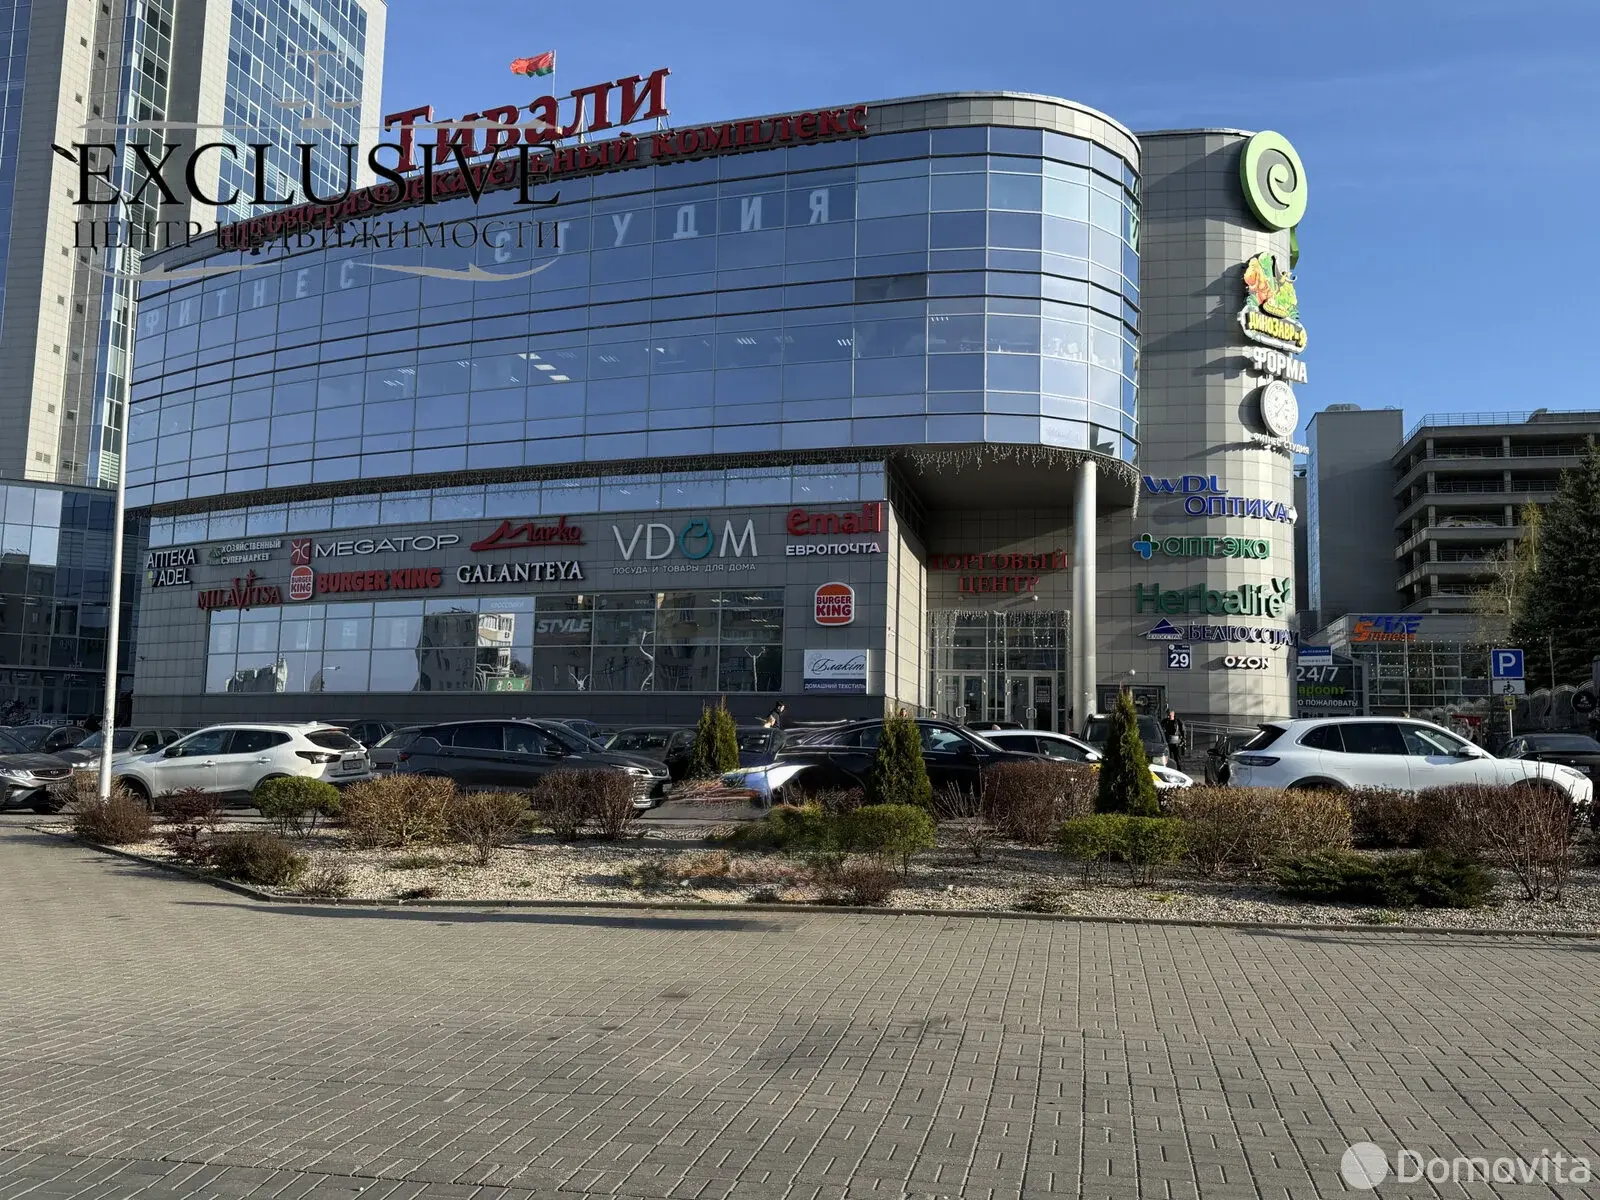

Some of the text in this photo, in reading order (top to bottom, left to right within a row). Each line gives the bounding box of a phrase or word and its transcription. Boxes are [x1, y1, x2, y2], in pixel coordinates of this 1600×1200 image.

[384, 68, 671, 173] Тивали
[652, 105, 868, 162] комплекс
[1253, 347, 1308, 383] ФОРМА
[1143, 475, 1228, 494] WDL
[1183, 495, 1288, 520] ОПТИКА
[221, 539, 281, 553] ХОЗЯЙСТВЕННЫЙ
[315, 534, 459, 557] MEGATOP
[612, 517, 758, 560] VDOM
[786, 542, 880, 556] ЕВРОПОЧТА
[146, 548, 195, 569] АПТЕКА
[221, 553, 270, 565] СУПЕРМАРКЕТ
[931, 548, 1068, 570] ТОРГОВЫЙ
[157, 568, 190, 586] ADEL
[456, 560, 584, 583] GALANTEYA
[613, 563, 756, 575] ПОСУДА И ТОВАРЫ ДЛЯ ДОМА
[290, 582, 312, 593] KING
[291, 575, 312, 583] BURGER
[316, 567, 441, 593] BURGER KING
[958, 575, 1040, 595] ЦЕНТР
[816, 596, 852, 605] BURGER
[1137, 577, 1286, 618] Herbalife
[816, 604, 852, 616] KING
[537, 618, 592, 633] STYLE
[1170, 653, 1190, 668] 29
[1224, 656, 1269, 668] OZON
[1296, 666, 1339, 682] 24/7
